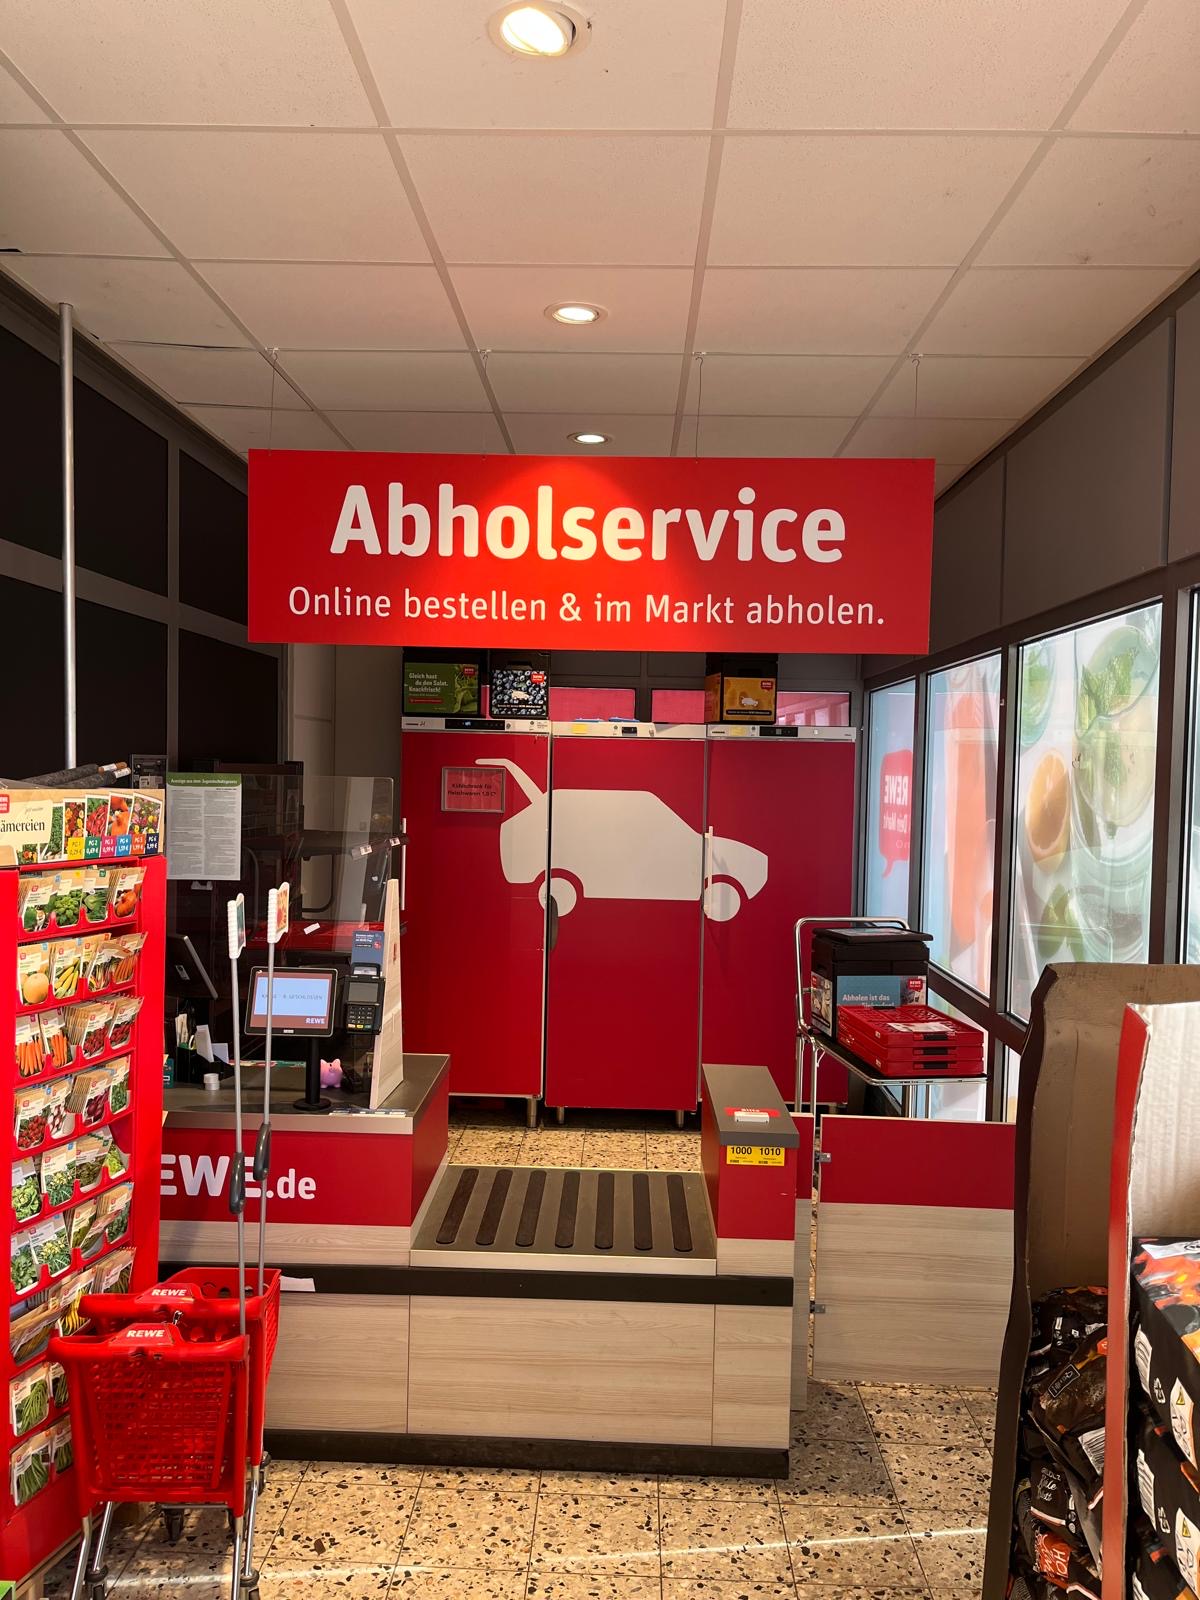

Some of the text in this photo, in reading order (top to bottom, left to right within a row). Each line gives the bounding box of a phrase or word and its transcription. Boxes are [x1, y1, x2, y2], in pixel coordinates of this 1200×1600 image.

[329, 482, 846, 562] Abholservice
[288, 585, 885, 626] Online bestellen & im Markt abholen.
[0, 818, 45, 832] ämereien
[731, 1146, 781, 1156] 1000 1010
[160, 1154, 317, 1200] EWE.de
[151, 1288, 187, 1296] REWE
[126, 1329, 165, 1338] REWE
